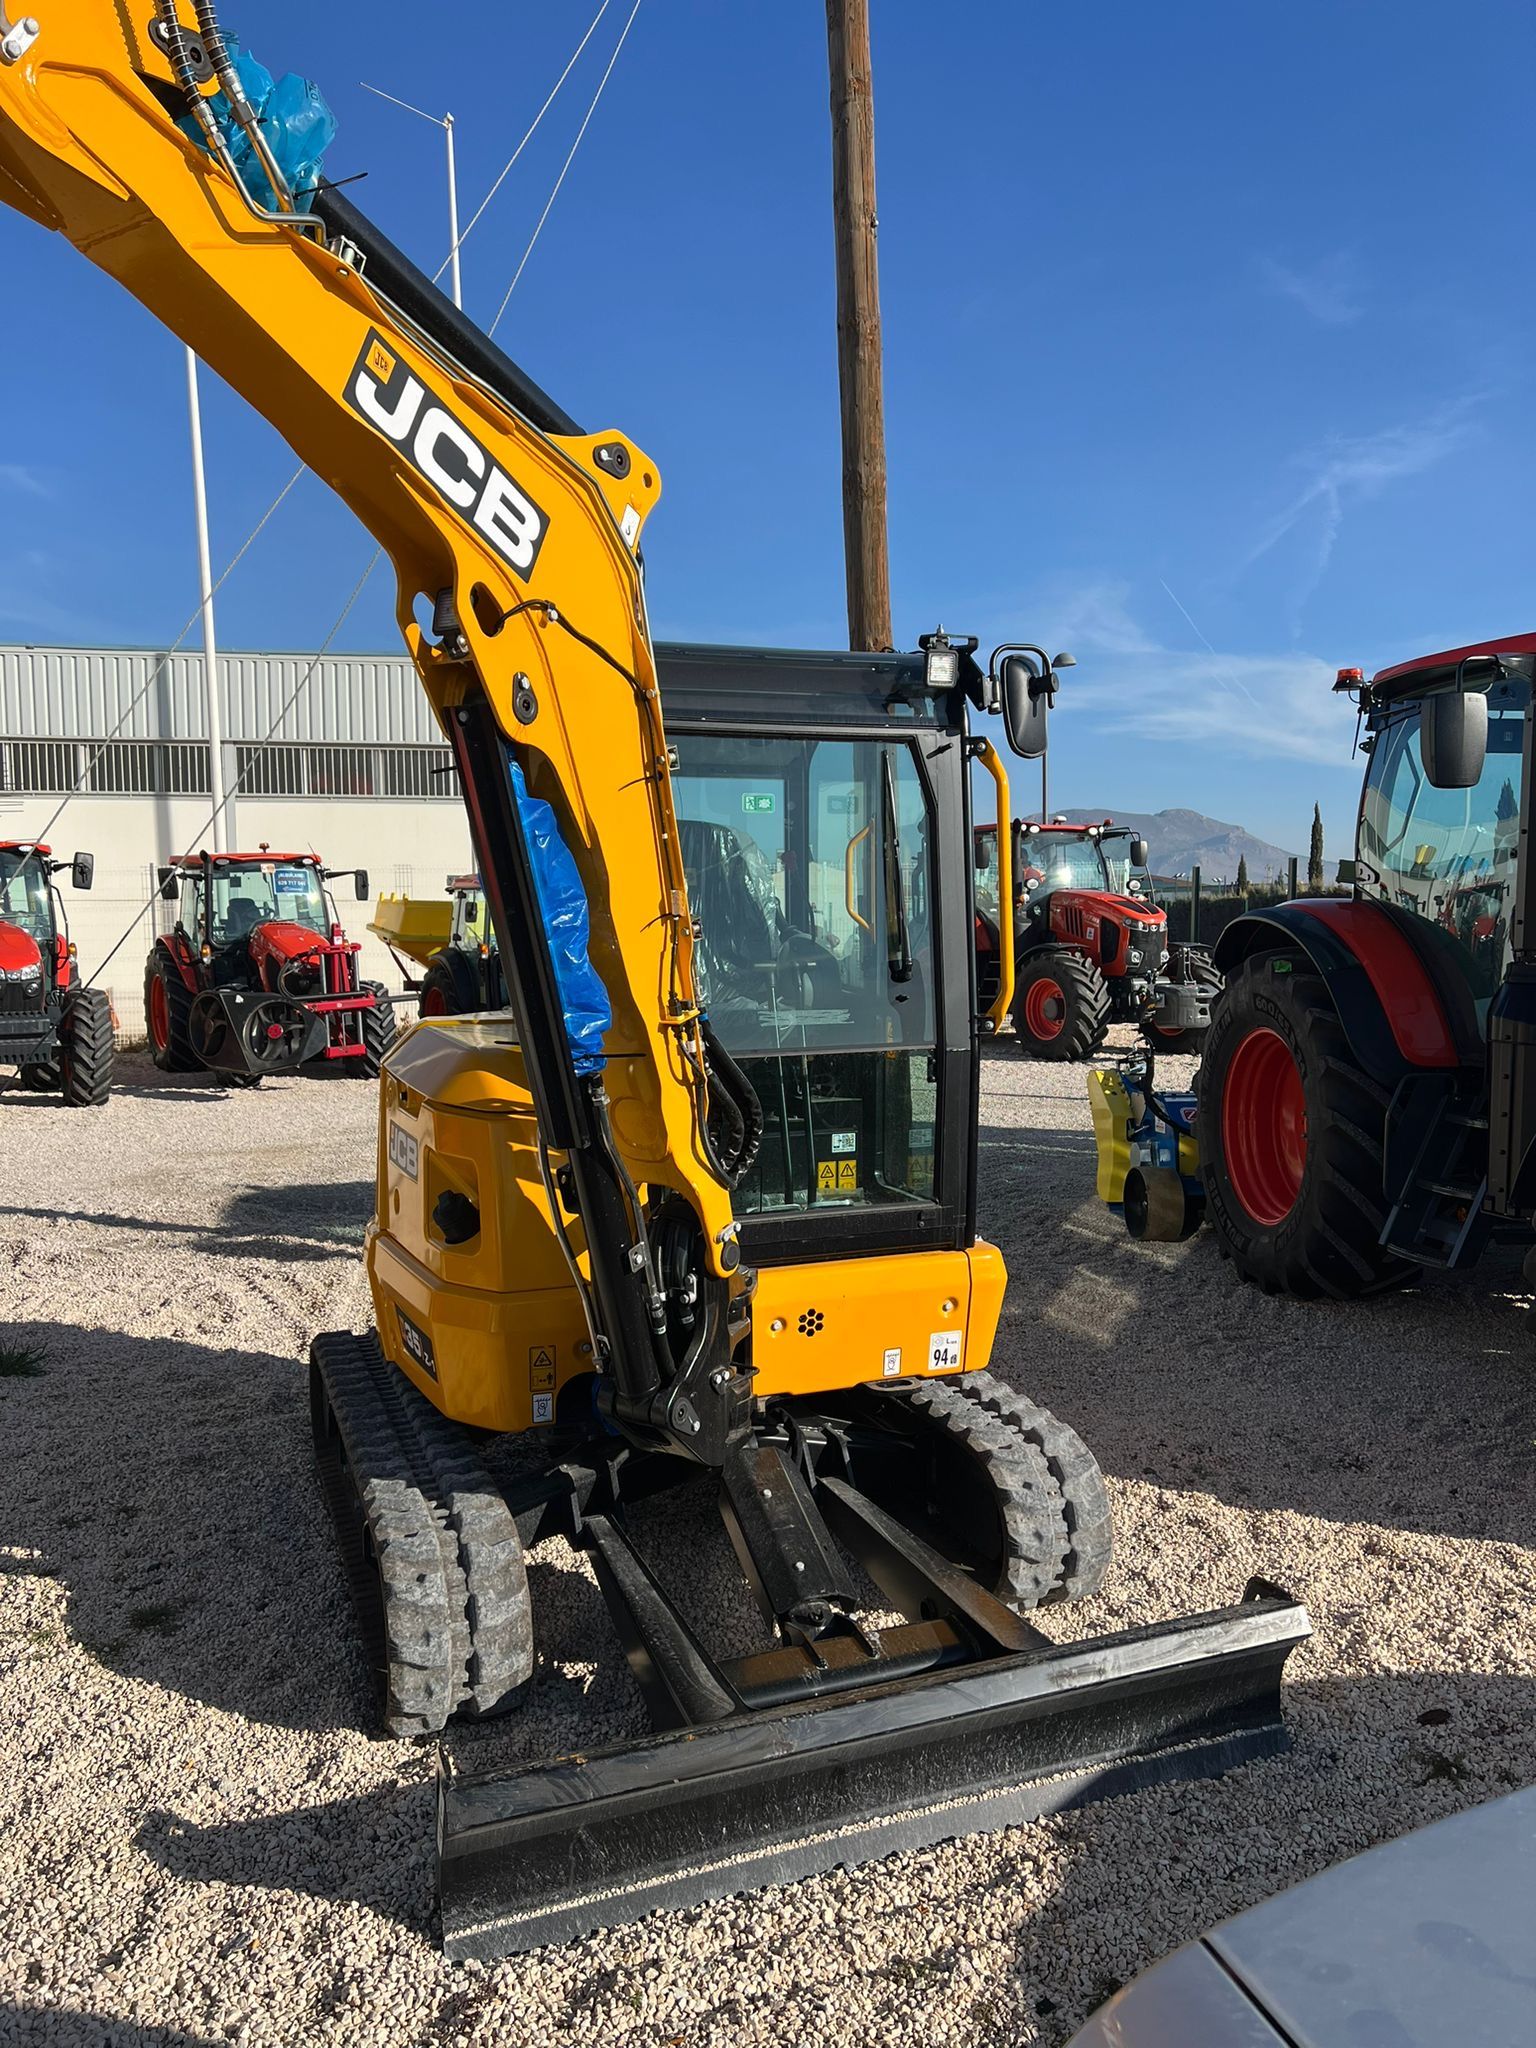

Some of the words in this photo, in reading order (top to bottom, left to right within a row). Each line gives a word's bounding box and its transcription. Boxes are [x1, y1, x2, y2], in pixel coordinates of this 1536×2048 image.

[374, 352, 389, 372] JCB
[354, 370, 541, 569] JCB
[390, 1124, 418, 1179] JCB
[404, 1321, 422, 1358] 35
[933, 1348, 949, 1367] 94
